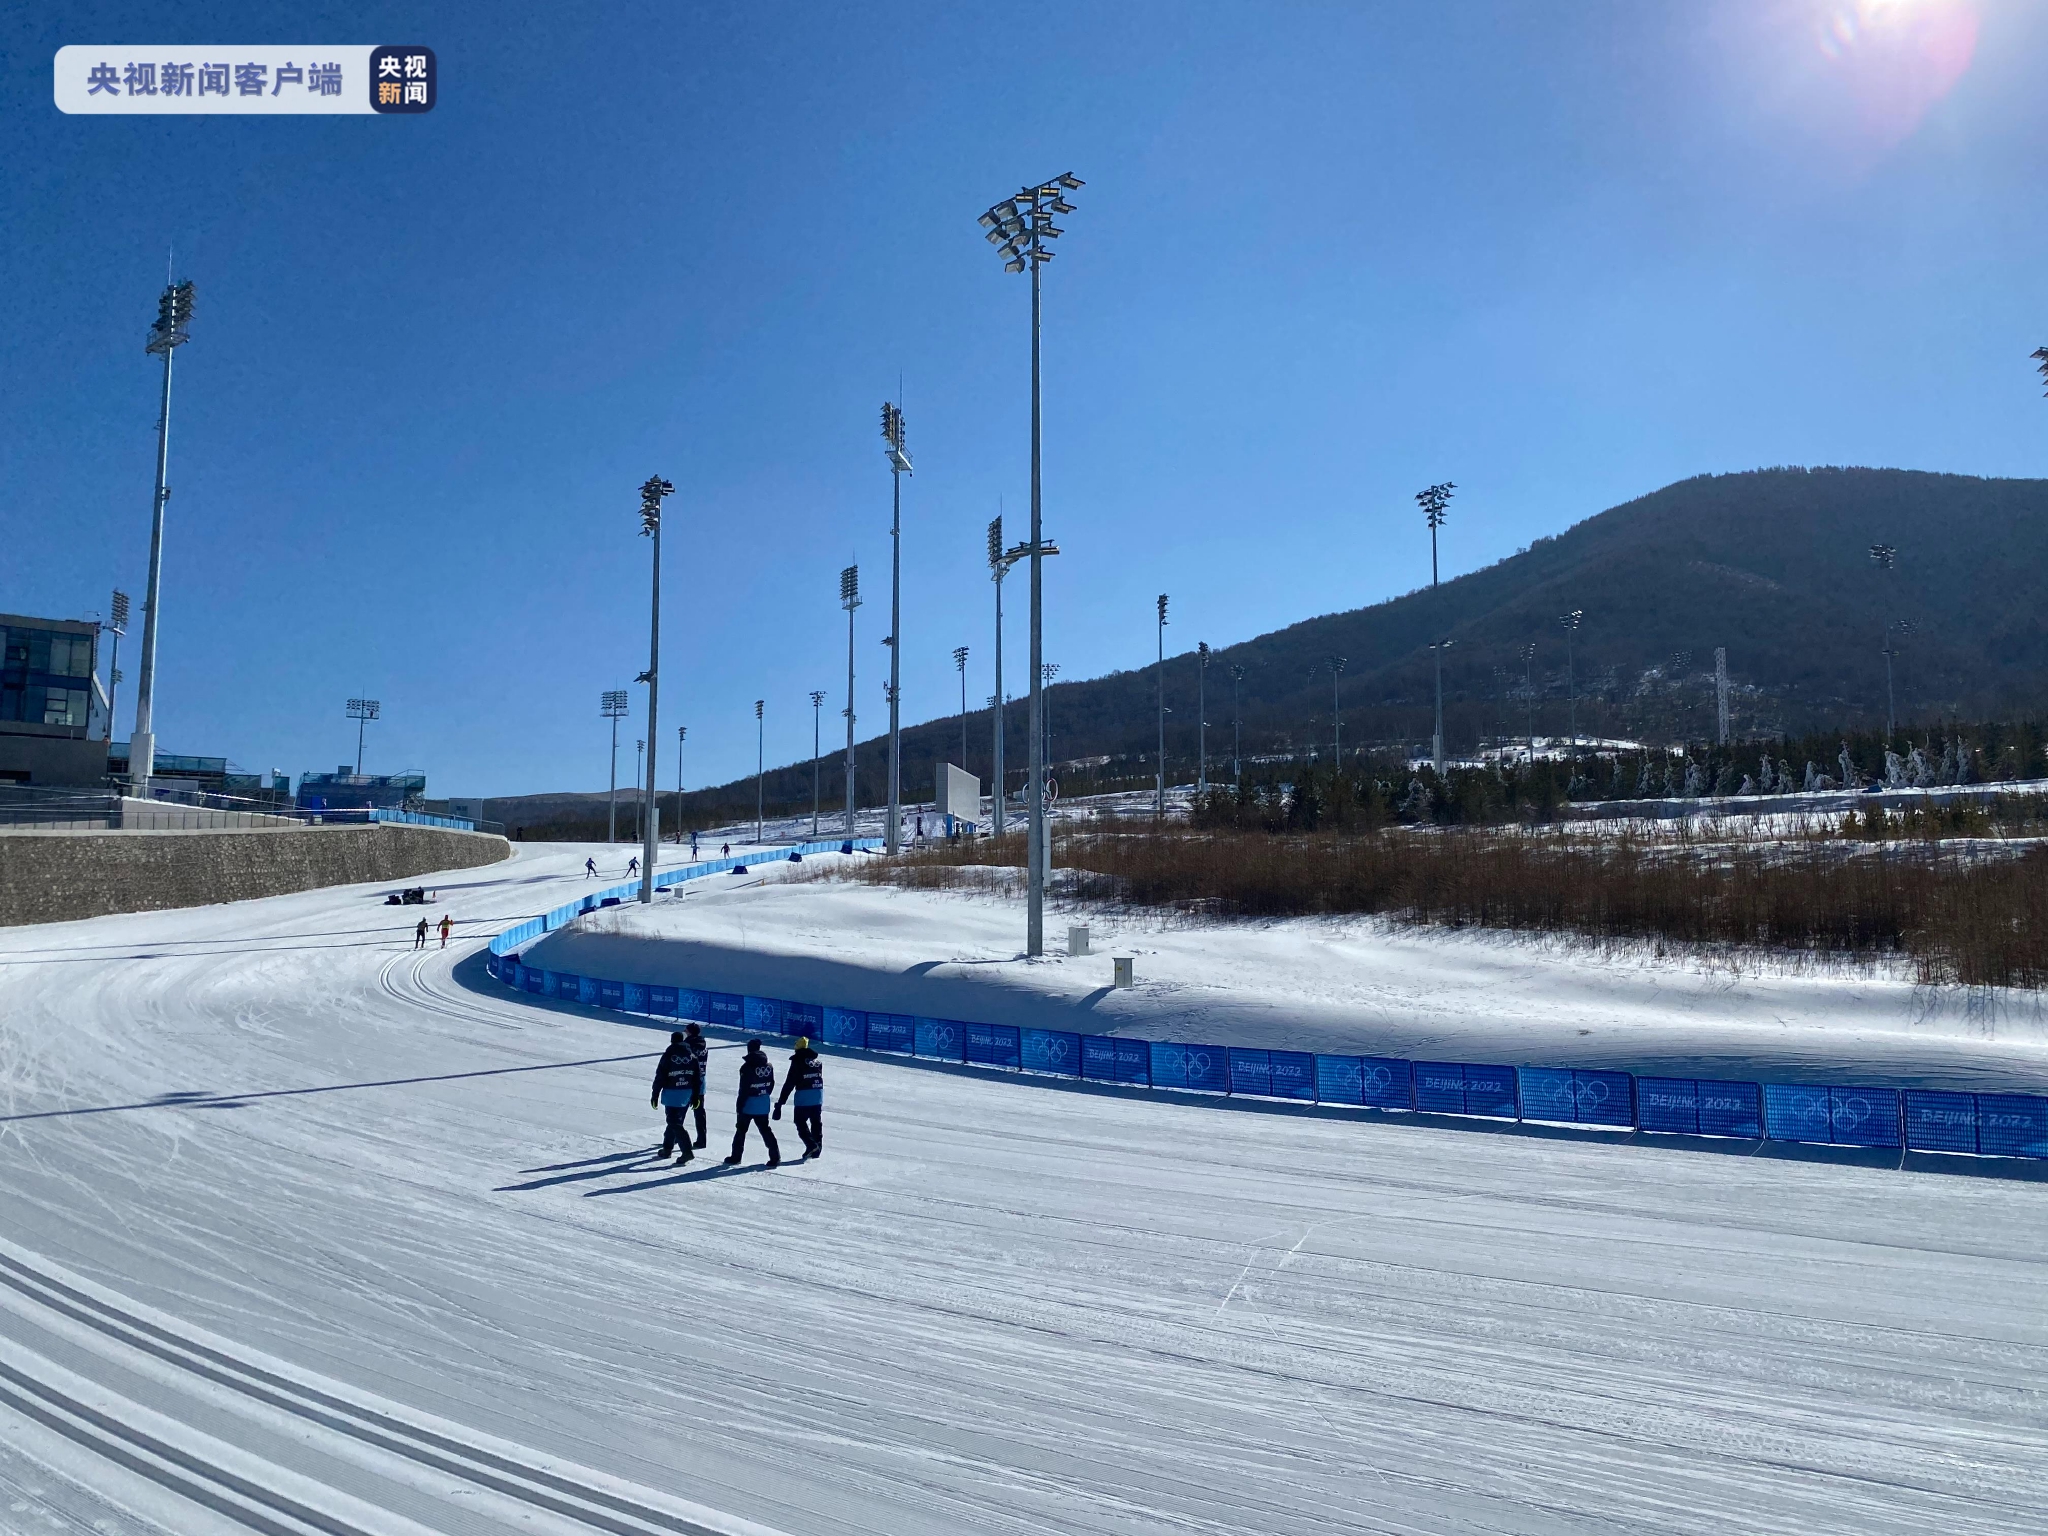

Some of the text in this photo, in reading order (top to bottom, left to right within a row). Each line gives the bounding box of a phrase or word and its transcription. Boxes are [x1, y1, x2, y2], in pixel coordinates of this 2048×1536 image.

[712, 1001, 738, 1012] BEIJING 2022
[786, 1011, 817, 1023] BEIJING 2022
[871, 1022, 907, 1034] BEIJING 2022
[971, 1034, 1013, 1047] BEIJING 2022
[1089, 1048, 1140, 1062] BEIJING 2022
[1238, 1061, 1301, 1077] BEIJING 2022
[1424, 1076, 1504, 1092] BEIJING 2022
[1649, 1093, 1742, 1111] BEIJING 2022
[1921, 1109, 2036, 1128] BEIJING 2022
